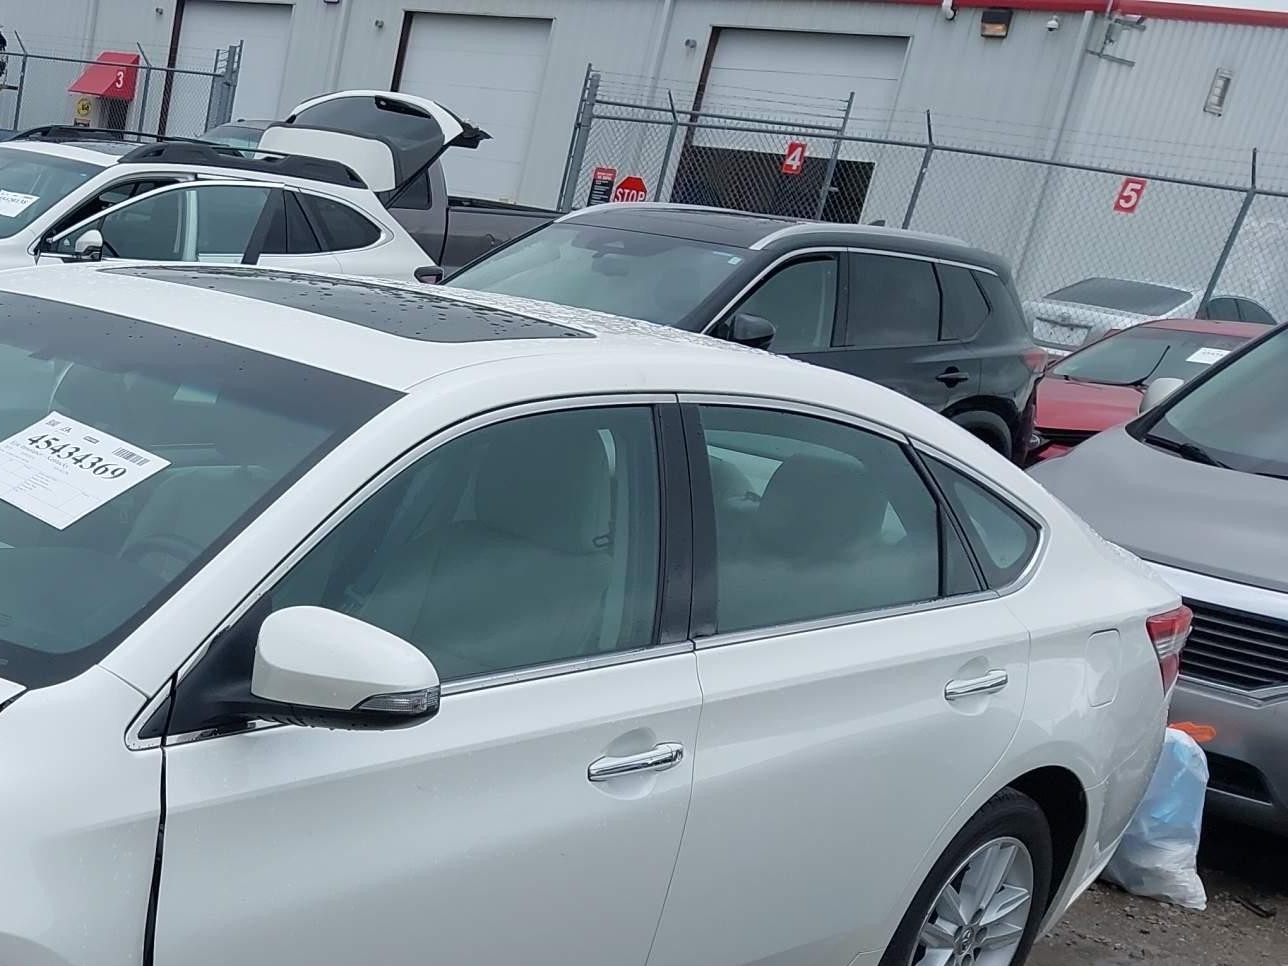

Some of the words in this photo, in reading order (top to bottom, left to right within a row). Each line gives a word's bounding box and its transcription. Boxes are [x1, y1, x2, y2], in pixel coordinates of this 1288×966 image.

[115, 71, 124, 88] 3
[786, 146, 803, 170] 4
[614, 187, 646, 202] STOP
[1119, 182, 1142, 209] 5
[27, 433, 127, 480] 45434369
